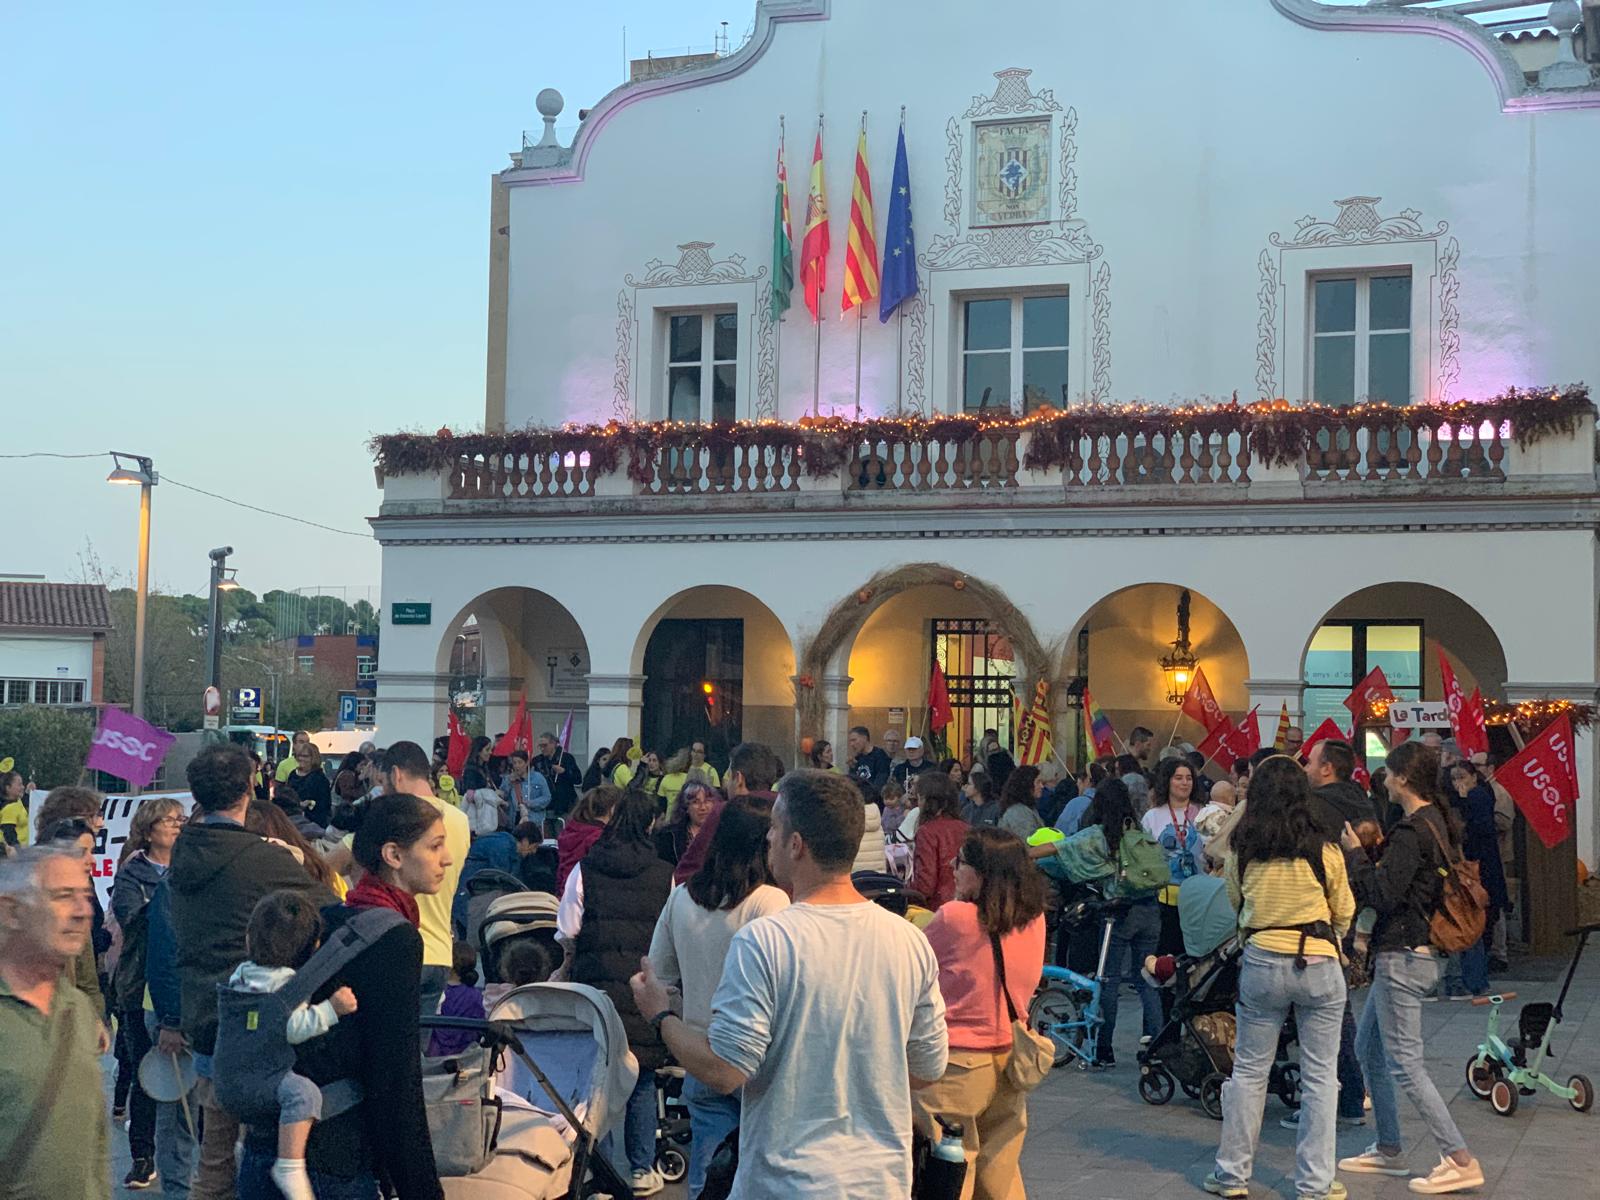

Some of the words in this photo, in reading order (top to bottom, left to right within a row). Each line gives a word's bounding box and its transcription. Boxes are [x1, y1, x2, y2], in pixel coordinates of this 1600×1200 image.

[343, 699, 353, 719] P
[1393, 709, 1409, 723] La
[1411, 707, 1450, 723] Tard
[1523, 758, 1566, 823] USOC
